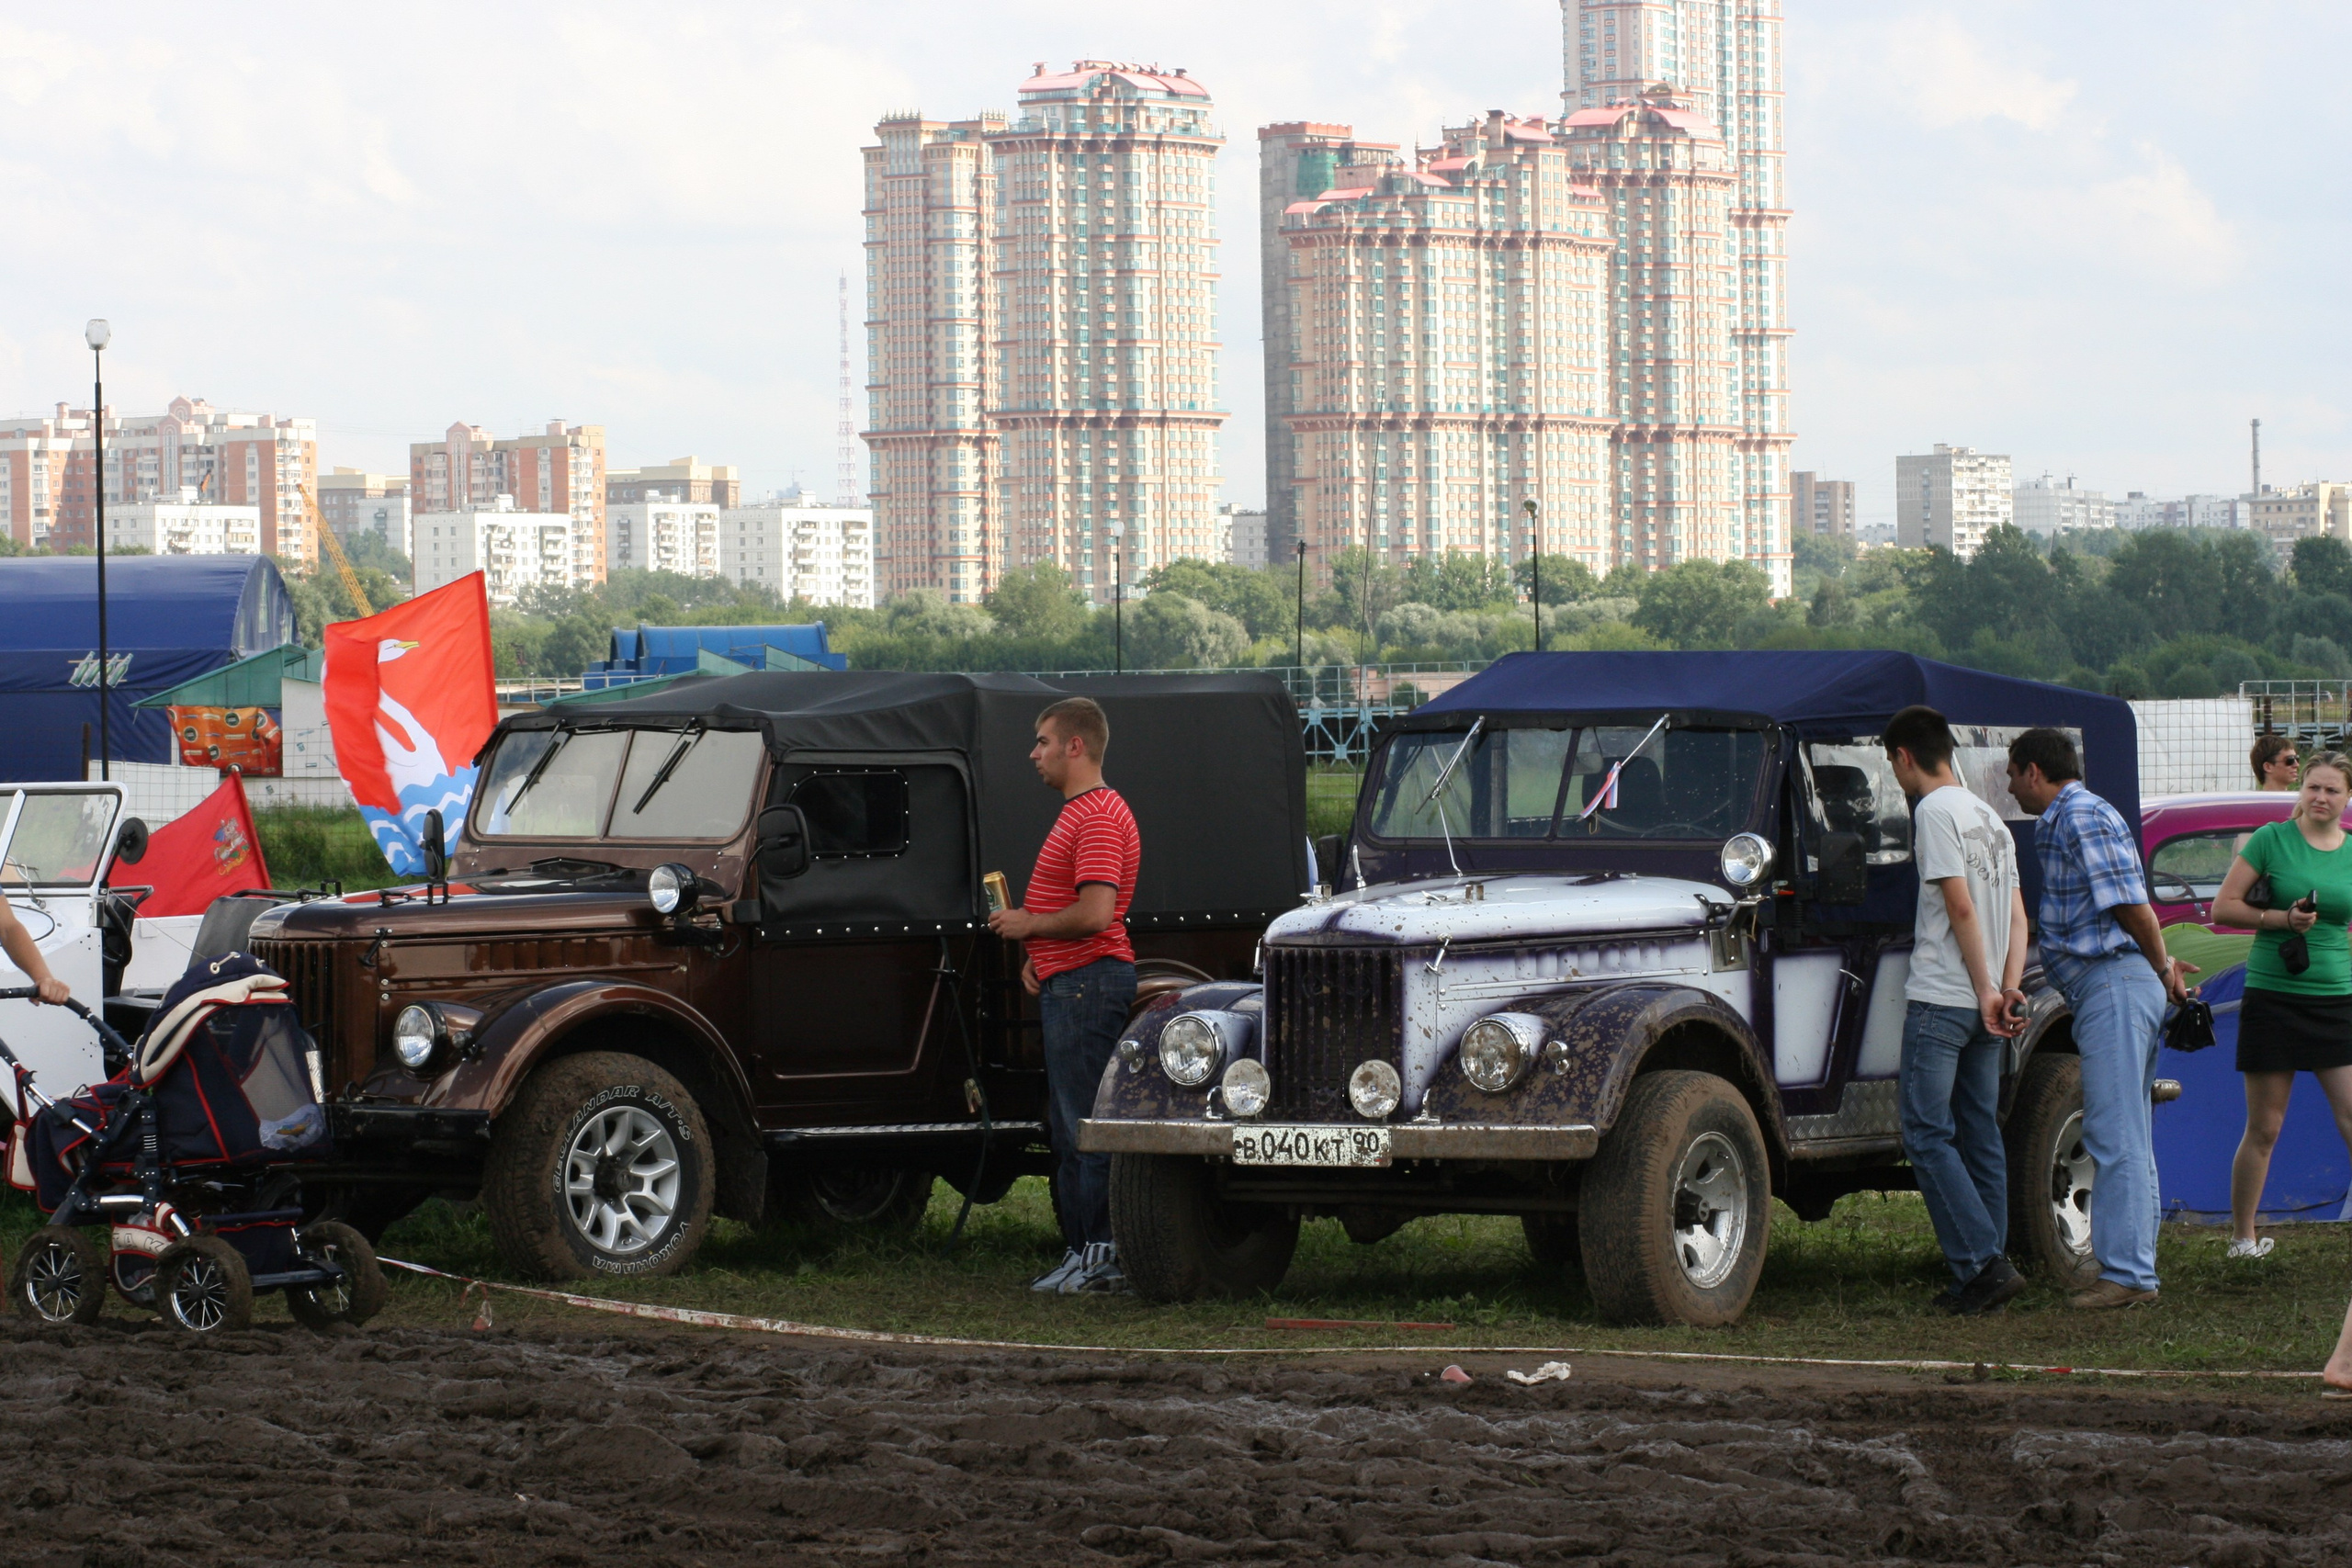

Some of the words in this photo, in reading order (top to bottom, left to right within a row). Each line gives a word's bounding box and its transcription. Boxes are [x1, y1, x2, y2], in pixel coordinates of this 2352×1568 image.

[553, 1085, 640, 1193] GEOLANDAR
[1352, 1132, 1379, 1153] 90
[593, 1221, 691, 1275] YOKOHAMA
